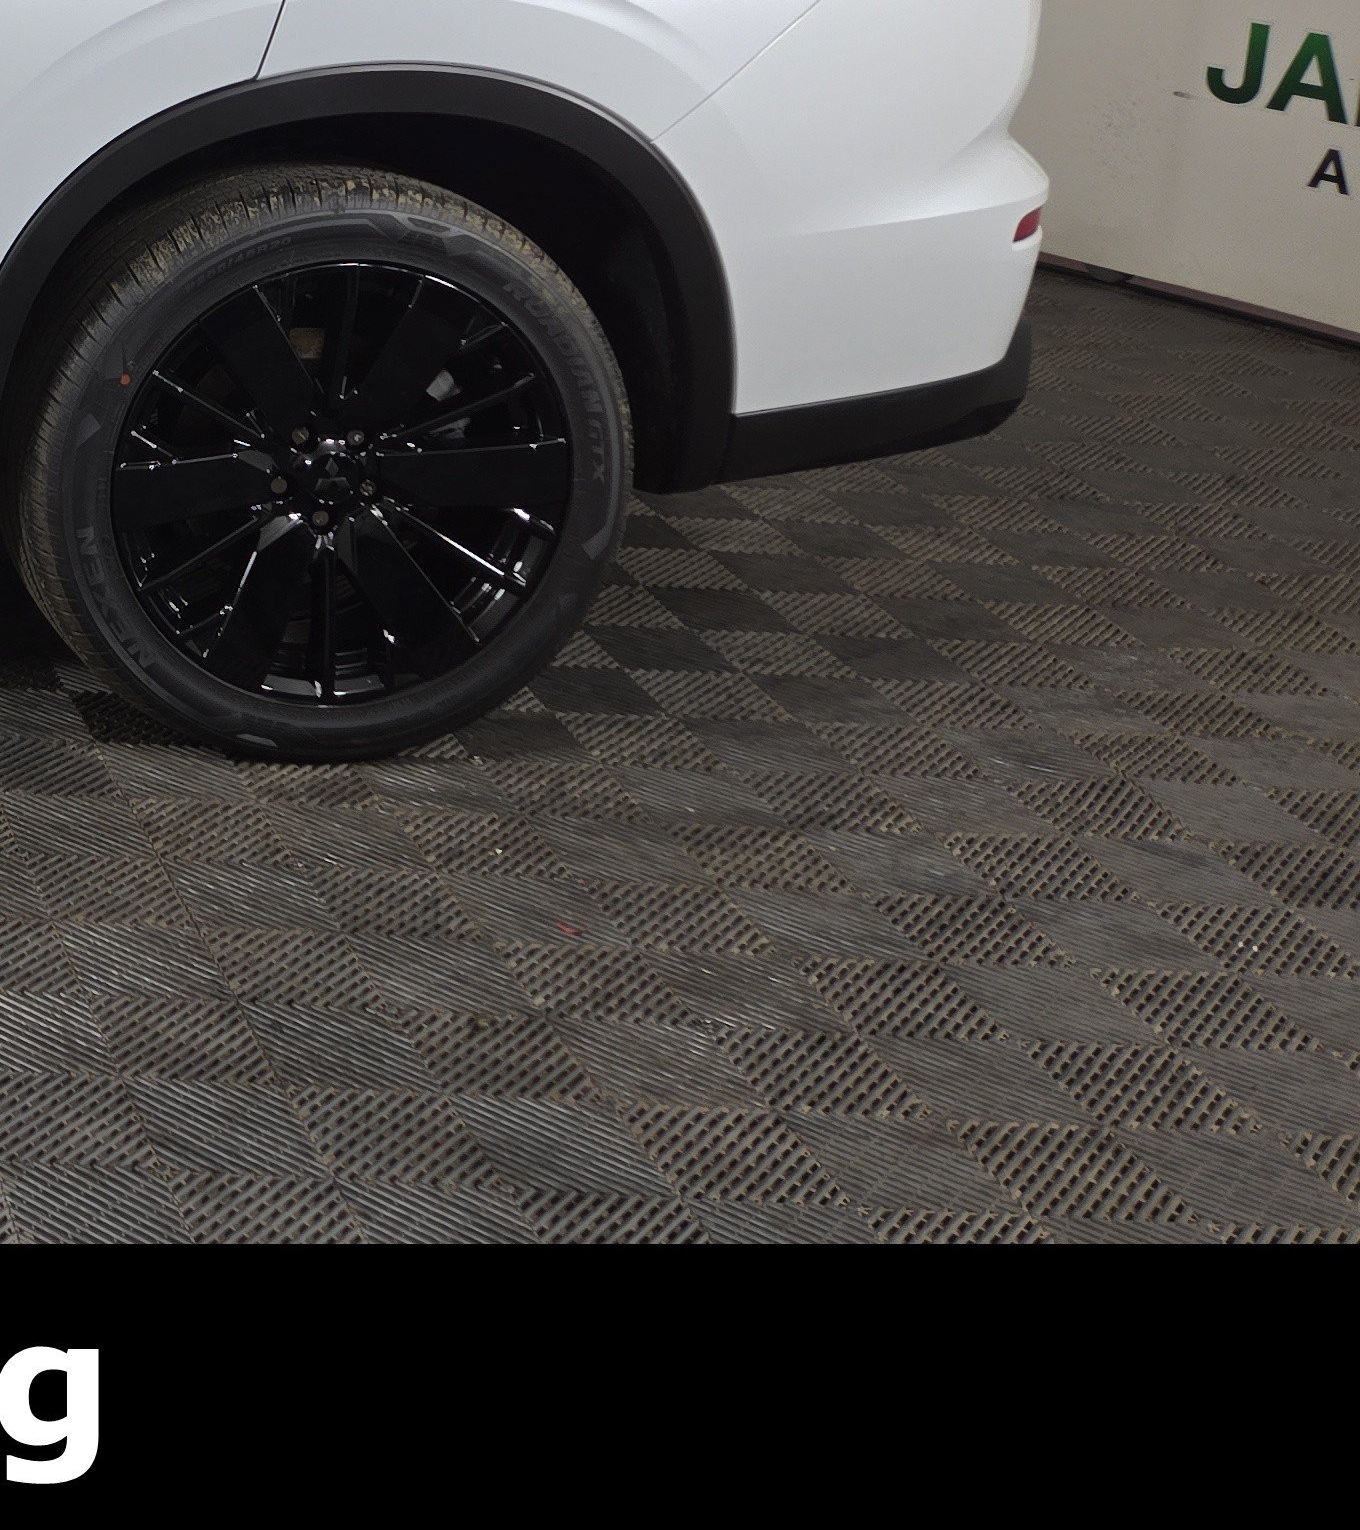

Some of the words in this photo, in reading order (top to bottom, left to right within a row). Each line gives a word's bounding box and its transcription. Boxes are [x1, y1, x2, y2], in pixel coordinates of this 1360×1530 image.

[1206, 22, 1360, 128] JA
[1308, 148, 1349, 196] A
[76, 525, 159, 669] NEXEN
